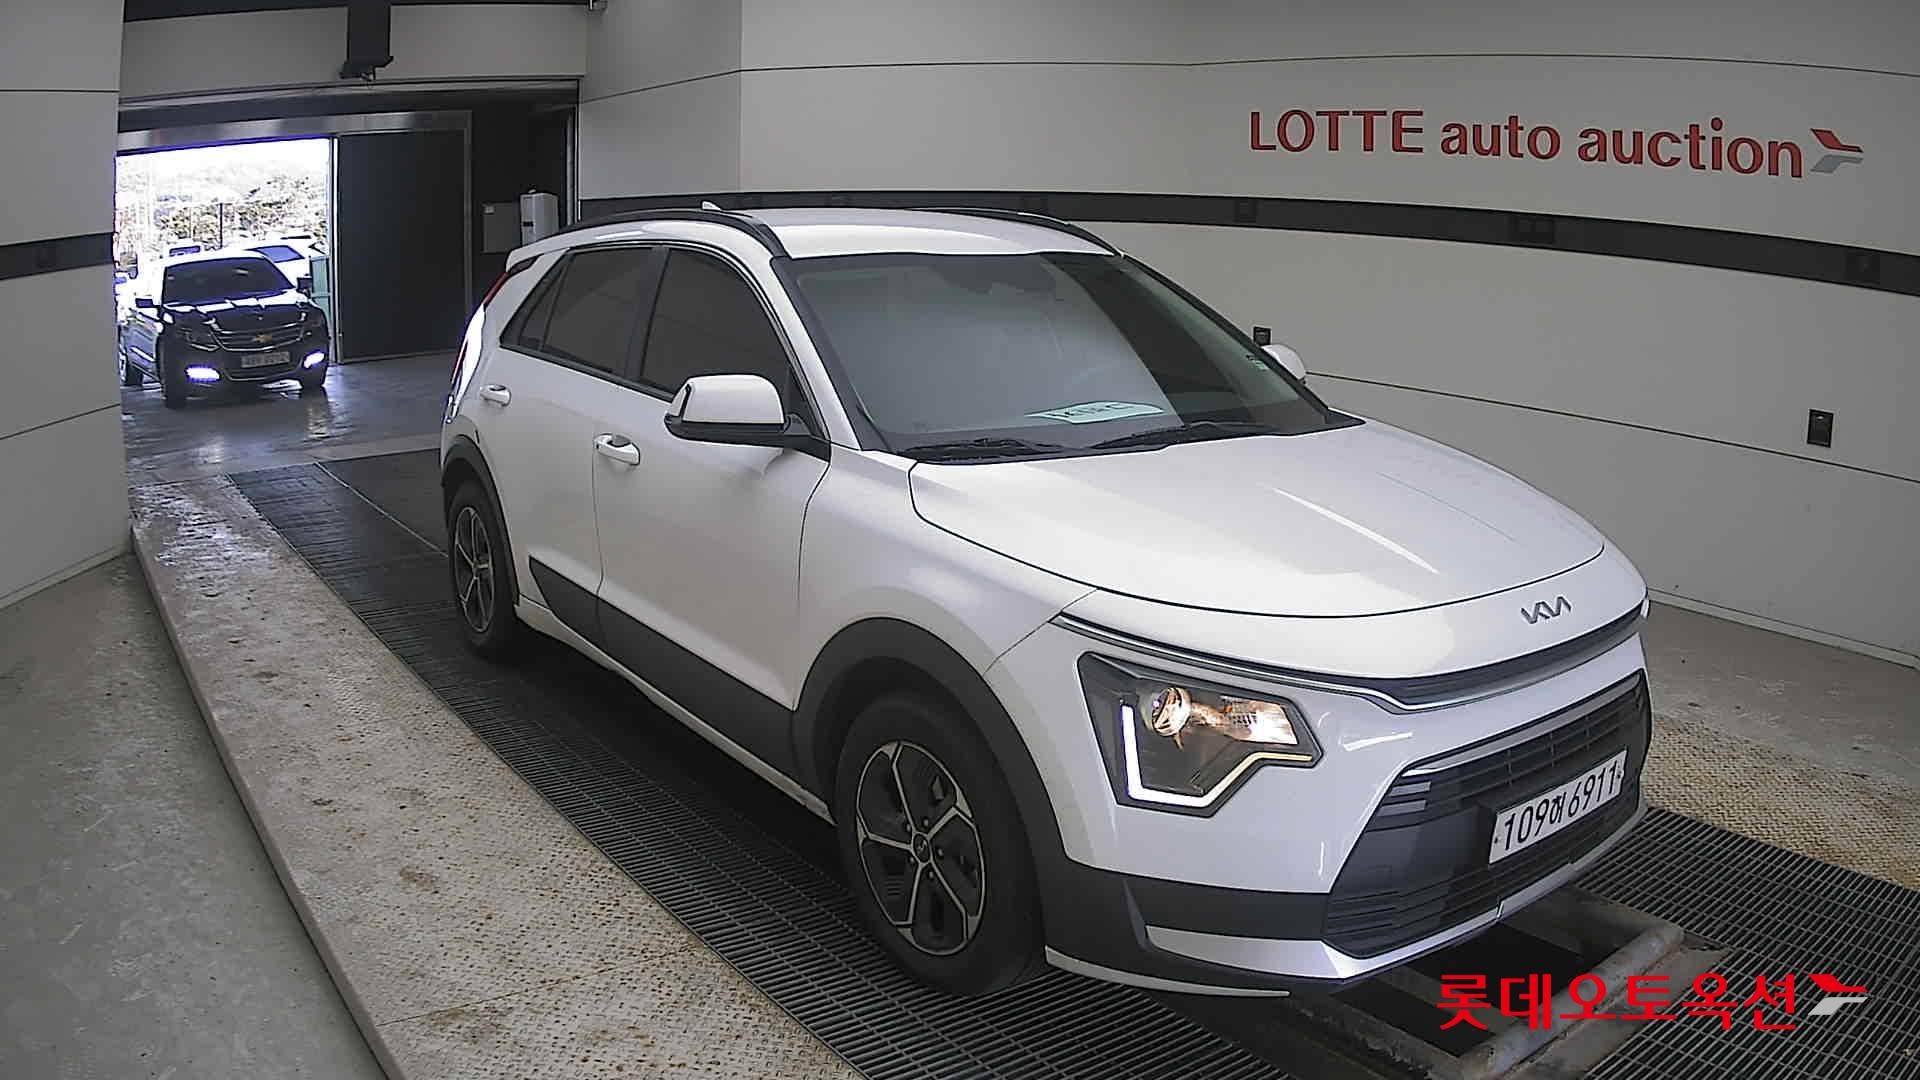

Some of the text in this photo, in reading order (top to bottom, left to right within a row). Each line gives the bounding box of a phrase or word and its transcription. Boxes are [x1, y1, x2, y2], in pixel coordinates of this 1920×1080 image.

[1250, 109, 1804, 178] LOTTE auto auction
